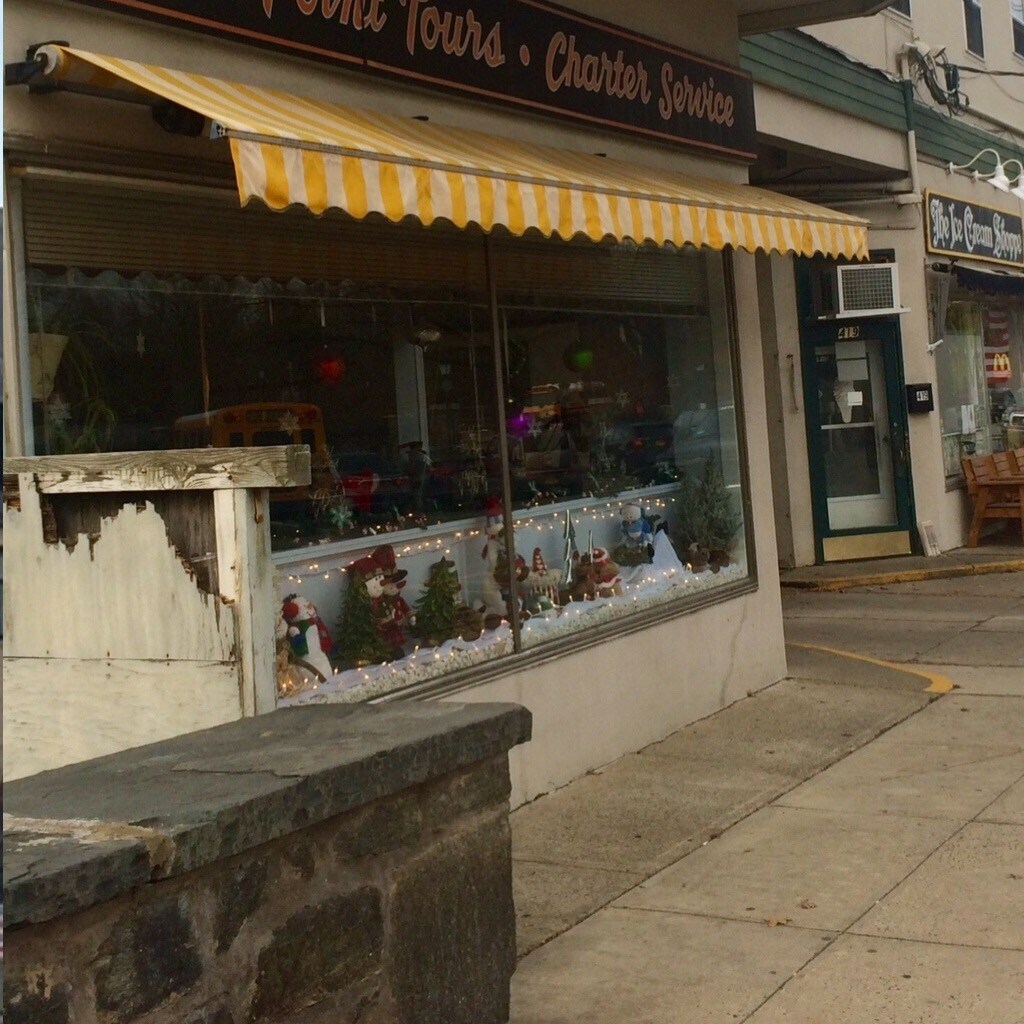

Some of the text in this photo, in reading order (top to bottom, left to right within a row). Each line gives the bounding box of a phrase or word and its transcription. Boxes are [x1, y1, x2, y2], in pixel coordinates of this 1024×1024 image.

[545, 31, 652, 105] Charter
[658, 62, 735, 128] Service
[930, 198, 1023, 262] The Ice Cream Shoppe
[838, 326, 860, 339] 419
